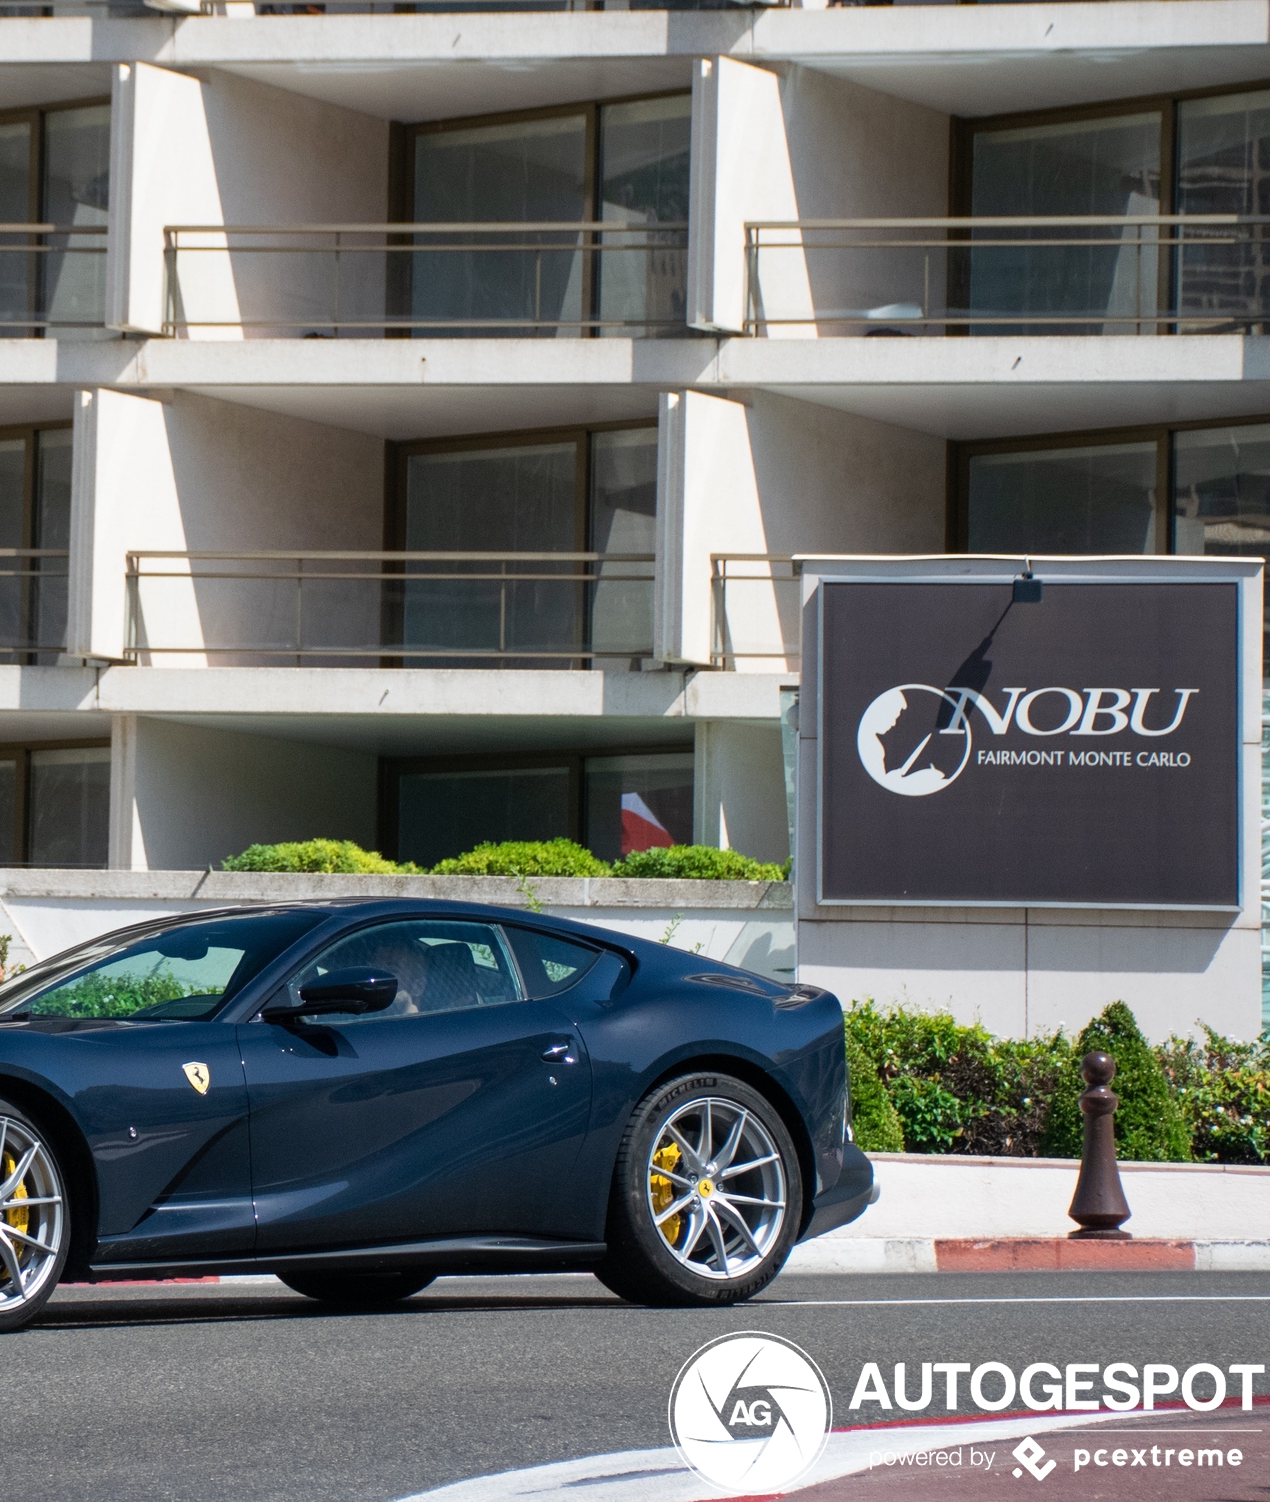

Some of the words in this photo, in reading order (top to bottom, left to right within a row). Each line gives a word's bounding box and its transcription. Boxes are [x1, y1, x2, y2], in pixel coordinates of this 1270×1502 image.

[939, 686, 1200, 737] NOBU
[977, 750, 1065, 766] FAIRMONT
[1068, 751, 1132, 767] MONTE
[1136, 751, 1192, 768] CARLO
[659, 1078, 715, 1109] MICHELIN
